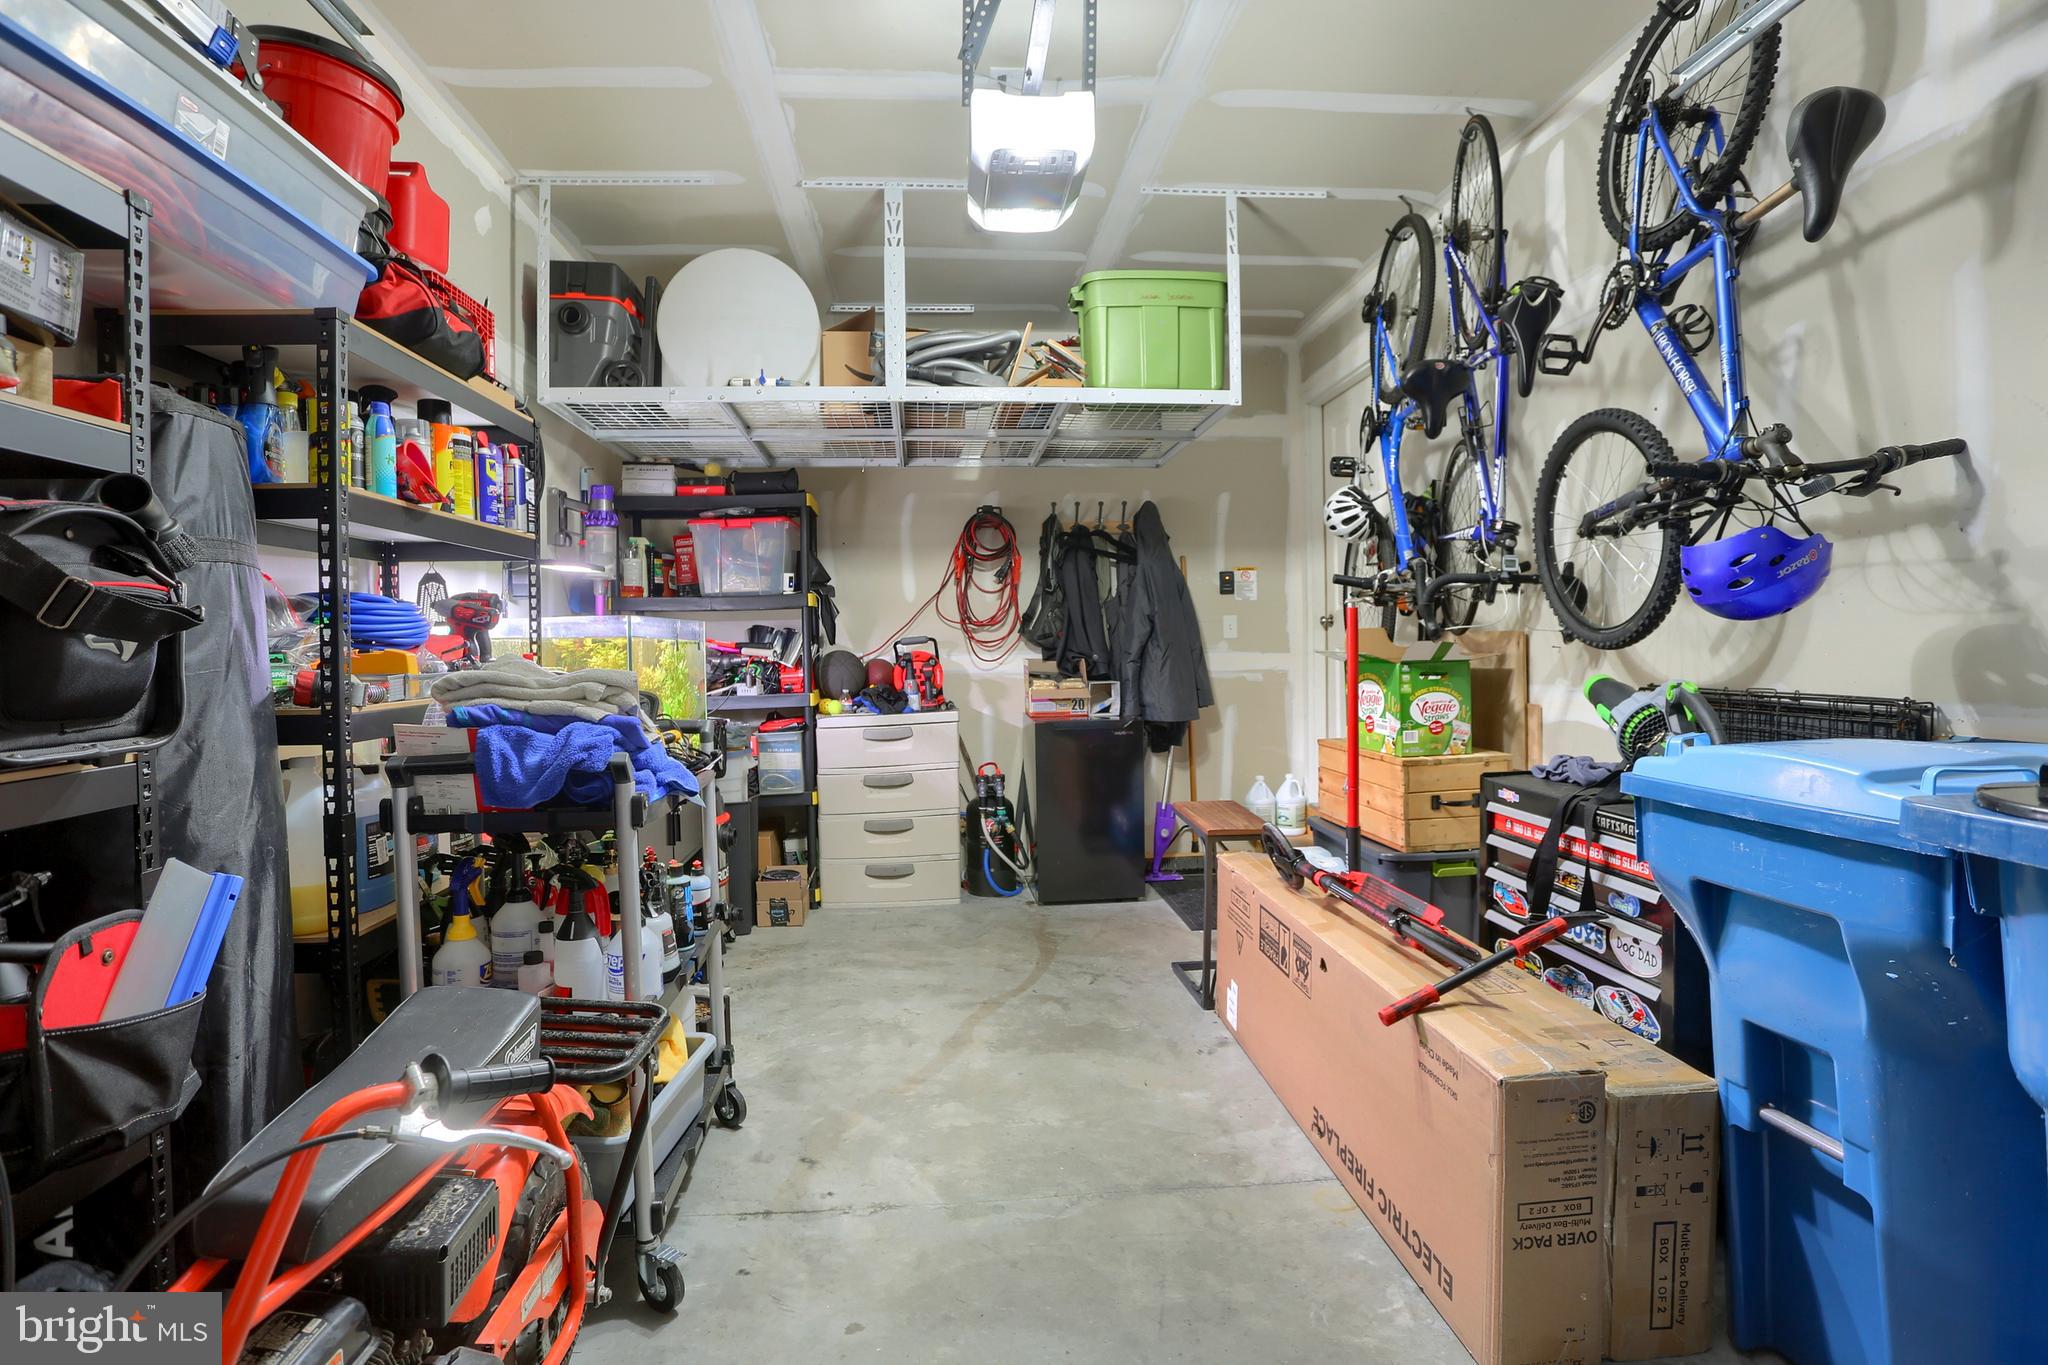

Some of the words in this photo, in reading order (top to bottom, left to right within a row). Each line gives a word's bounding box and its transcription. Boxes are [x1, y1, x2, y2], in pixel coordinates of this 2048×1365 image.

[1652, 331, 1675, 363] IRON
[1668, 357, 1698, 396] HORSE
[1071, 699, 1085, 711] 20
[1417, 701, 1456, 717] Veggie
[1622, 857, 1650, 875] SLIDES
[1616, 936, 1635, 957] DOG
[1638, 947, 1658, 968] DAD
[1441, 1059, 1459, 1081] Made
[1311, 1105, 1375, 1201] FIREPLACE
[1528, 1207, 1535, 1216] 2
[1536, 1205, 1548, 1214] OF
[1550, 1205, 1557, 1213] 2
[1563, 1202, 1582, 1213] BOX
[1519, 1219, 1552, 1231] Delivery
[1553, 1217, 1591, 1229] Multi-Box
[1377, 1188, 1454, 1302] ELECTRIC
[1512, 1233, 1553, 1251] PACK
[1557, 1230, 1597, 1248] OVER
[1658, 1238, 1669, 1264] BOX
[1679, 1222, 1691, 1278] Multi-Box
[1658, 1286, 1668, 1303] OF
[1675, 1279, 1689, 1326] Delivery
